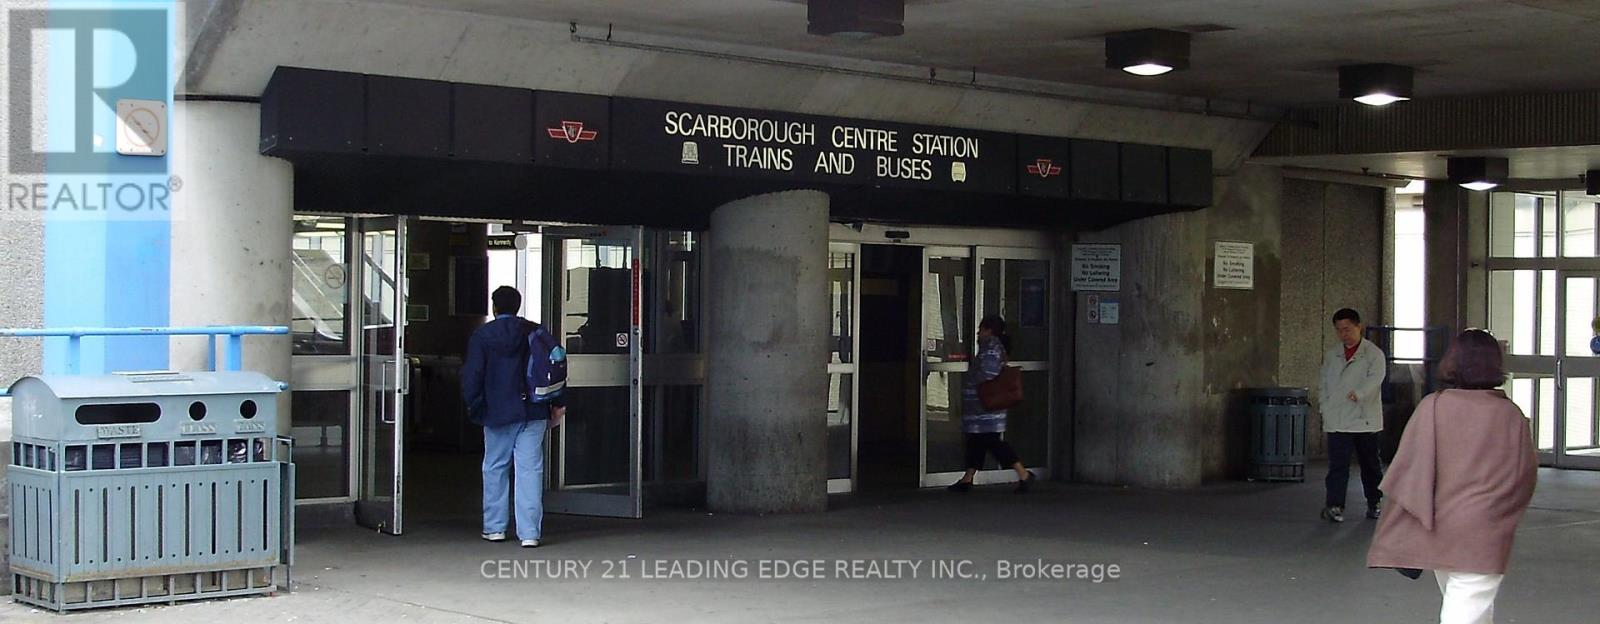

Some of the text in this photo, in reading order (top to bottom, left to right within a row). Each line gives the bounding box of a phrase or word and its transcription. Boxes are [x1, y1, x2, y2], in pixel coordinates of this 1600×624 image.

[664, 111, 978, 159] SCARBOROUGH CENTRE STATION
[723, 144, 932, 180] TRAINS AND BUSES
[98, 425, 140, 437] WASTE
